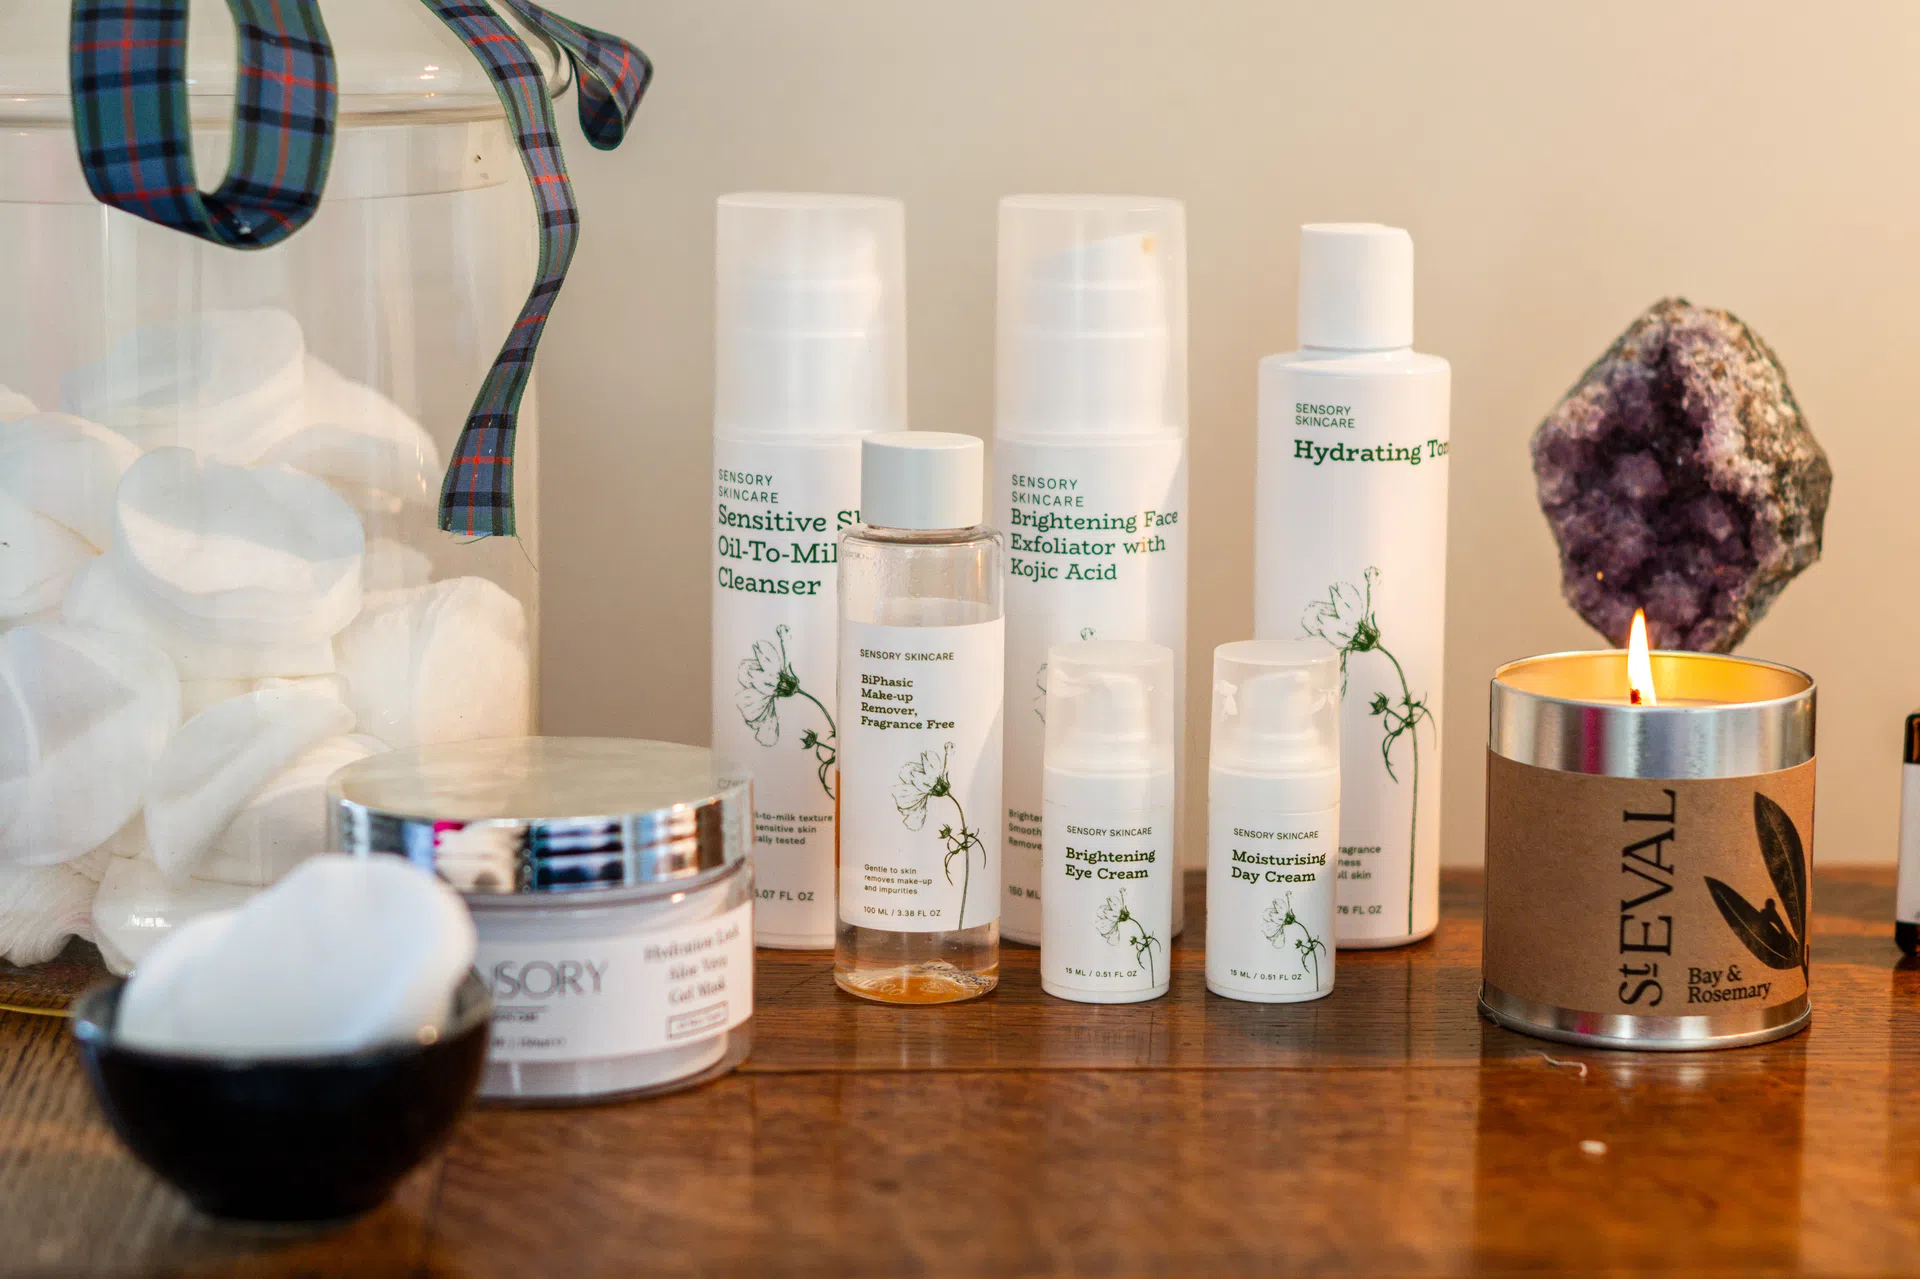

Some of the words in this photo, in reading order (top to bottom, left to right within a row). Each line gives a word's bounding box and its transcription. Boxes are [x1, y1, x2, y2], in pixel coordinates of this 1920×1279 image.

[1295, 402, 1351, 415] SENSORY
[1295, 415, 1355, 428] SKINCARE
[1293, 439, 1422, 466] Hydrating
[718, 468, 773, 486] SENSORY
[1011, 474, 1078, 490] SENSORY
[718, 485, 779, 504] SKINCARE
[1011, 491, 1084, 508] SKINCARE
[718, 503, 827, 532] Sensitive
[1010, 507, 1137, 533] Brightening
[1143, 510, 1179, 528] Face
[718, 534, 838, 563] Oil-To-Mil
[1010, 532, 1116, 556] Exfoliator
[1122, 535, 1166, 555] with
[1010, 557, 1058, 583] Kojic
[1064, 563, 1118, 581] Acid
[718, 566, 821, 595] Cleanser
[860, 648, 901, 661] SENSORY
[904, 651, 954, 661] SKINCARE
[861, 673, 914, 688] BiPhasic
[861, 687, 914, 704] Make-up
[861, 701, 918, 717] Remover,
[860, 715, 923, 730] Fragrance
[926, 719, 955, 729] Free
[755, 811, 796, 822] l-to-milk
[798, 814, 833, 822] texture
[755, 824, 794, 834] sensitive
[797, 825, 817, 834] skin
[1066, 825, 1107, 837] SENSORY
[1109, 826, 1152, 837] SKINCARE
[1233, 828, 1274, 840] SENSORY
[1276, 831, 1319, 840] SKINCARE
[775, 837, 806, 846] tested
[1065, 847, 1156, 864] Brightening
[1232, 849, 1326, 866] Moisturising
[1338, 846, 1382, 856] ragrance
[864, 863, 888, 874] Gentle
[900, 867, 917, 875] skin
[1337, 859, 1362, 867] ness
[1065, 864, 1093, 880] Eye
[1097, 868, 1149, 880] Cream
[1231, 867, 1260, 884] Day
[1265, 871, 1316, 883] Cream
[1351, 870, 1372, 880] skin
[1618, 788, 1677, 957] EVAL
[864, 874, 895, 884] removes
[897, 877, 933, 887] make-up
[779, 891, 794, 901] FL
[797, 891, 814, 901] OZ
[864, 884, 877, 892] and
[879, 885, 918, 895] impurities
[1008, 885, 1023, 897] 150
[1026, 888, 1041, 900] ML
[863, 905, 876, 914] 100
[878, 907, 888, 916] ML
[897, 909, 915, 917] 3.38
[917, 909, 927, 917] FL
[930, 909, 941, 917] OZ
[1337, 905, 1349, 914] 76
[1352, 906, 1365, 915] FL
[1368, 905, 1382, 915] OZ
[491, 958, 609, 1000] SORY
[1065, 967, 1073, 975] 15
[1075, 968, 1087, 977] ML
[1095, 970, 1112, 978] 0.51
[1114, 970, 1124, 978] FL
[1230, 969, 1238, 977] 15
[1240, 971, 1251, 979] ML
[1687, 967, 1723, 988] Bay
[1726, 964, 1743, 983] &
[1687, 982, 1772, 1004] Rosemary
